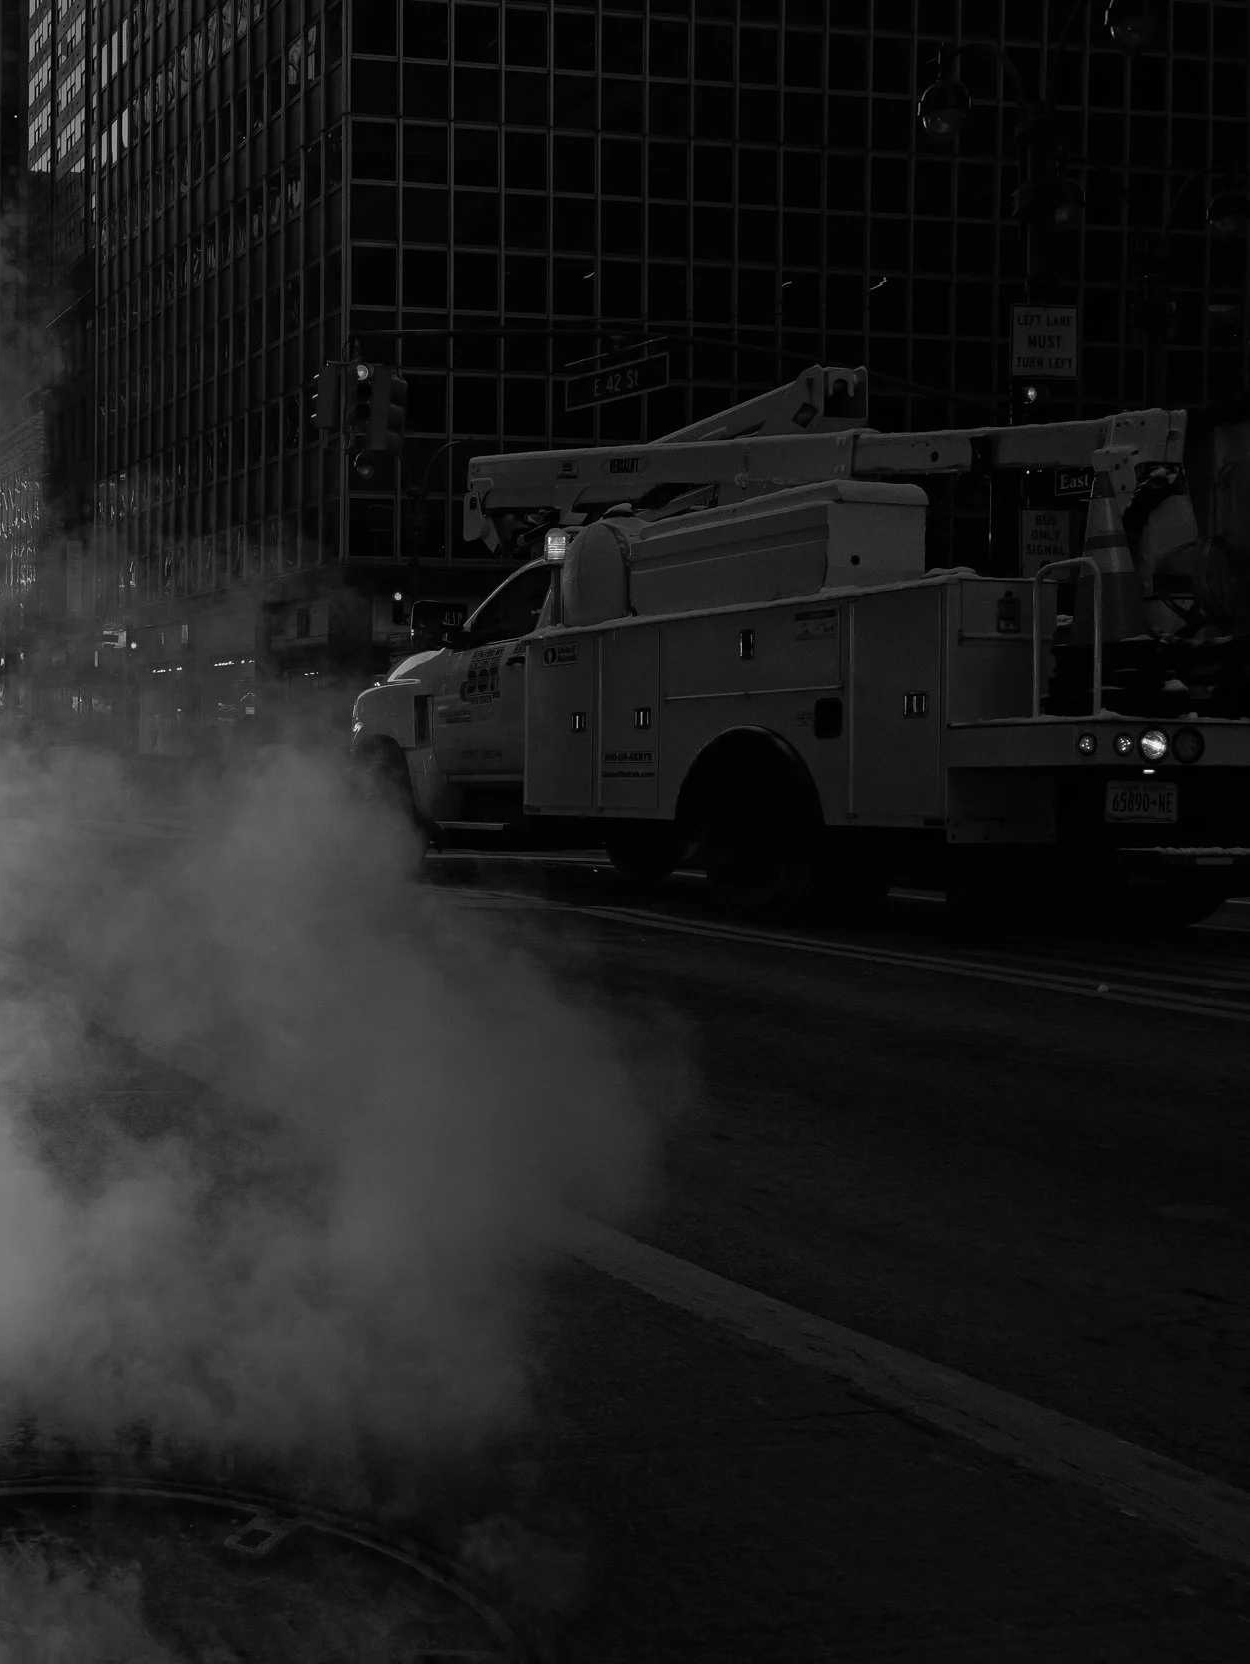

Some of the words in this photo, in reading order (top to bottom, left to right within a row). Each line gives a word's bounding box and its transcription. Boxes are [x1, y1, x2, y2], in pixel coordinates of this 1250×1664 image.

[1016, 314, 1041, 326] LEFT
[1047, 315, 1073, 327] LANE
[1027, 335, 1061, 348] MUST
[1016, 357, 1043, 369] TURN
[1049, 358, 1073, 369] LEFT
[594, 378, 601, 397] E
[605, 373, 622, 392] 42
[626, 368, 640, 389] St
[1059, 473, 1089, 490] East
[1035, 514, 1057, 526] BUS
[1031, 530, 1061, 541] ONLY
[1026, 544, 1067, 556] SIGNAL
